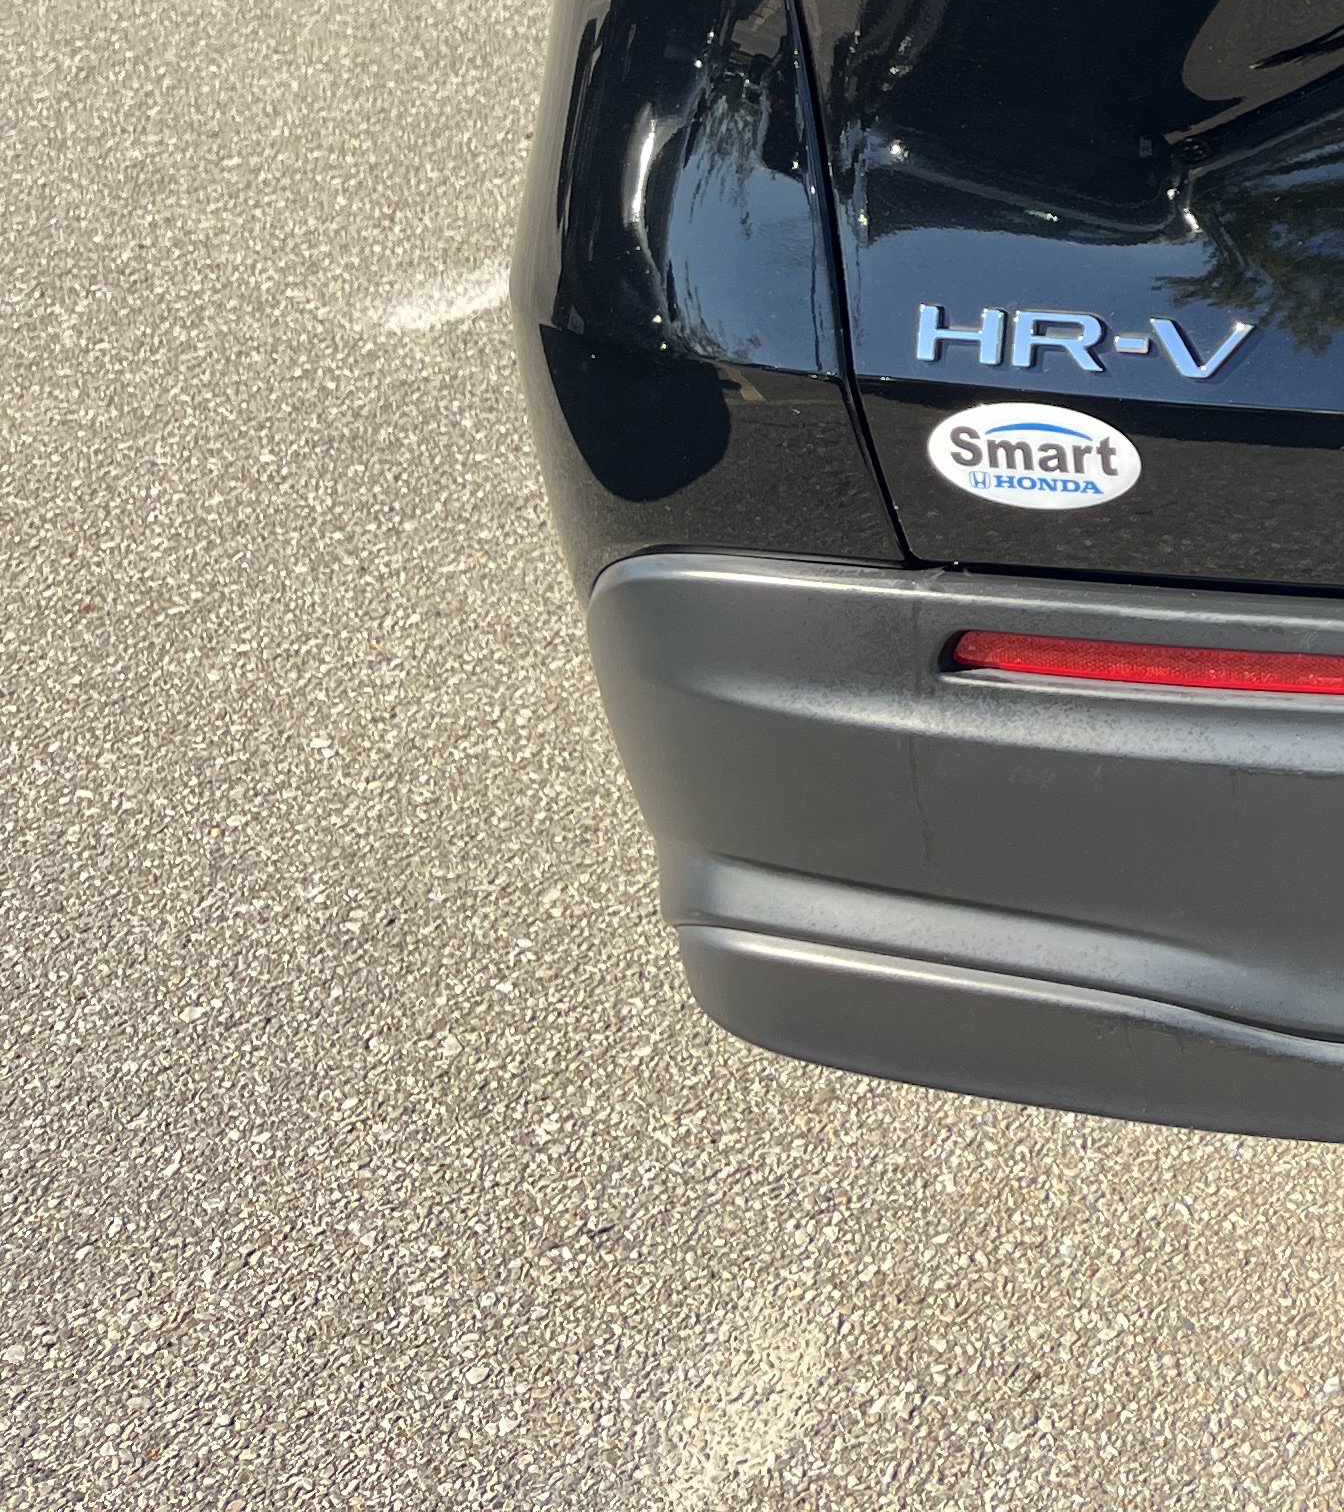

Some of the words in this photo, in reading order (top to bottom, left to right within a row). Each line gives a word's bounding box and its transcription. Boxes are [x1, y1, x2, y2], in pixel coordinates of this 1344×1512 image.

[915, 302, 1256, 380] HR-V
[950, 426, 1119, 477] Smart
[993, 474, 1104, 495] HONDA
